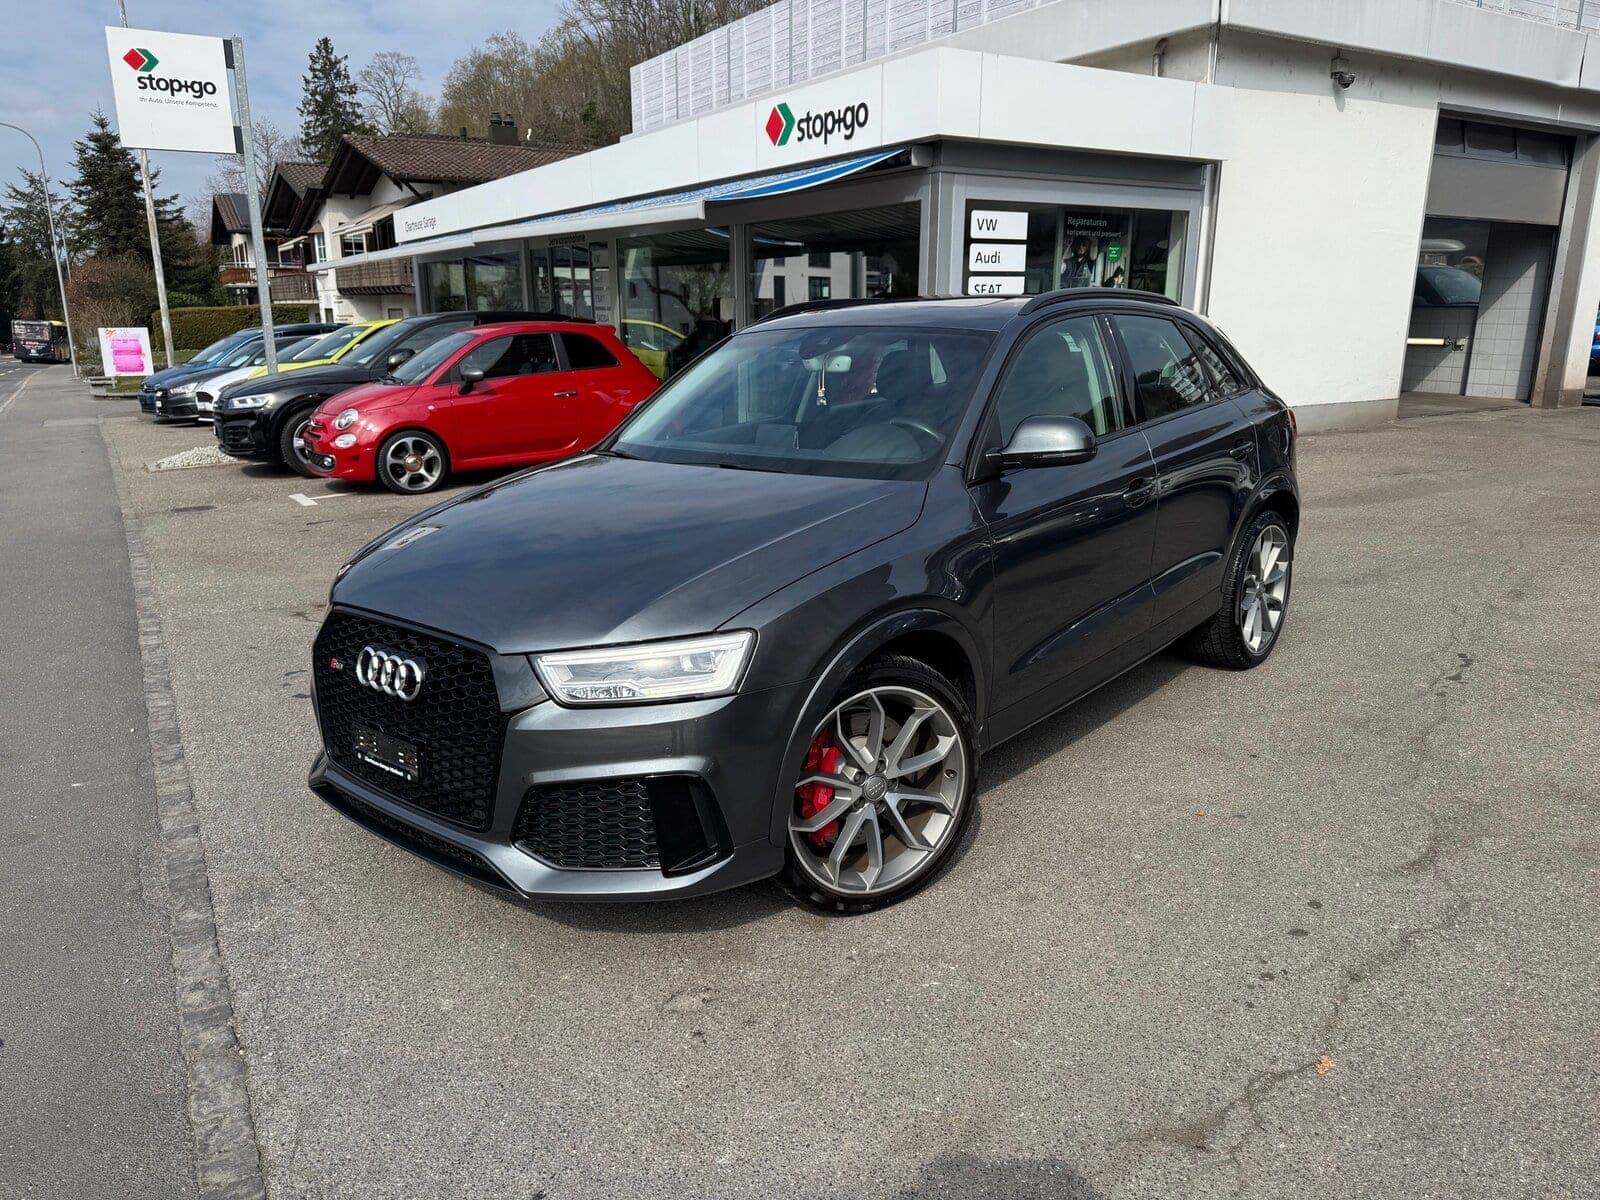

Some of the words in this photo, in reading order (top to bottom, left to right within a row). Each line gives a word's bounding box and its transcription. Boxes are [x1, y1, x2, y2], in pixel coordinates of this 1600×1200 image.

[137, 74, 217, 99] stop+go
[797, 102, 869, 145] stop+go
[976, 218, 998, 232] VW
[1067, 216, 1108, 227] Reparaturen
[975, 251, 1001, 264] Audi
[974, 283, 1003, 294] SEAT
